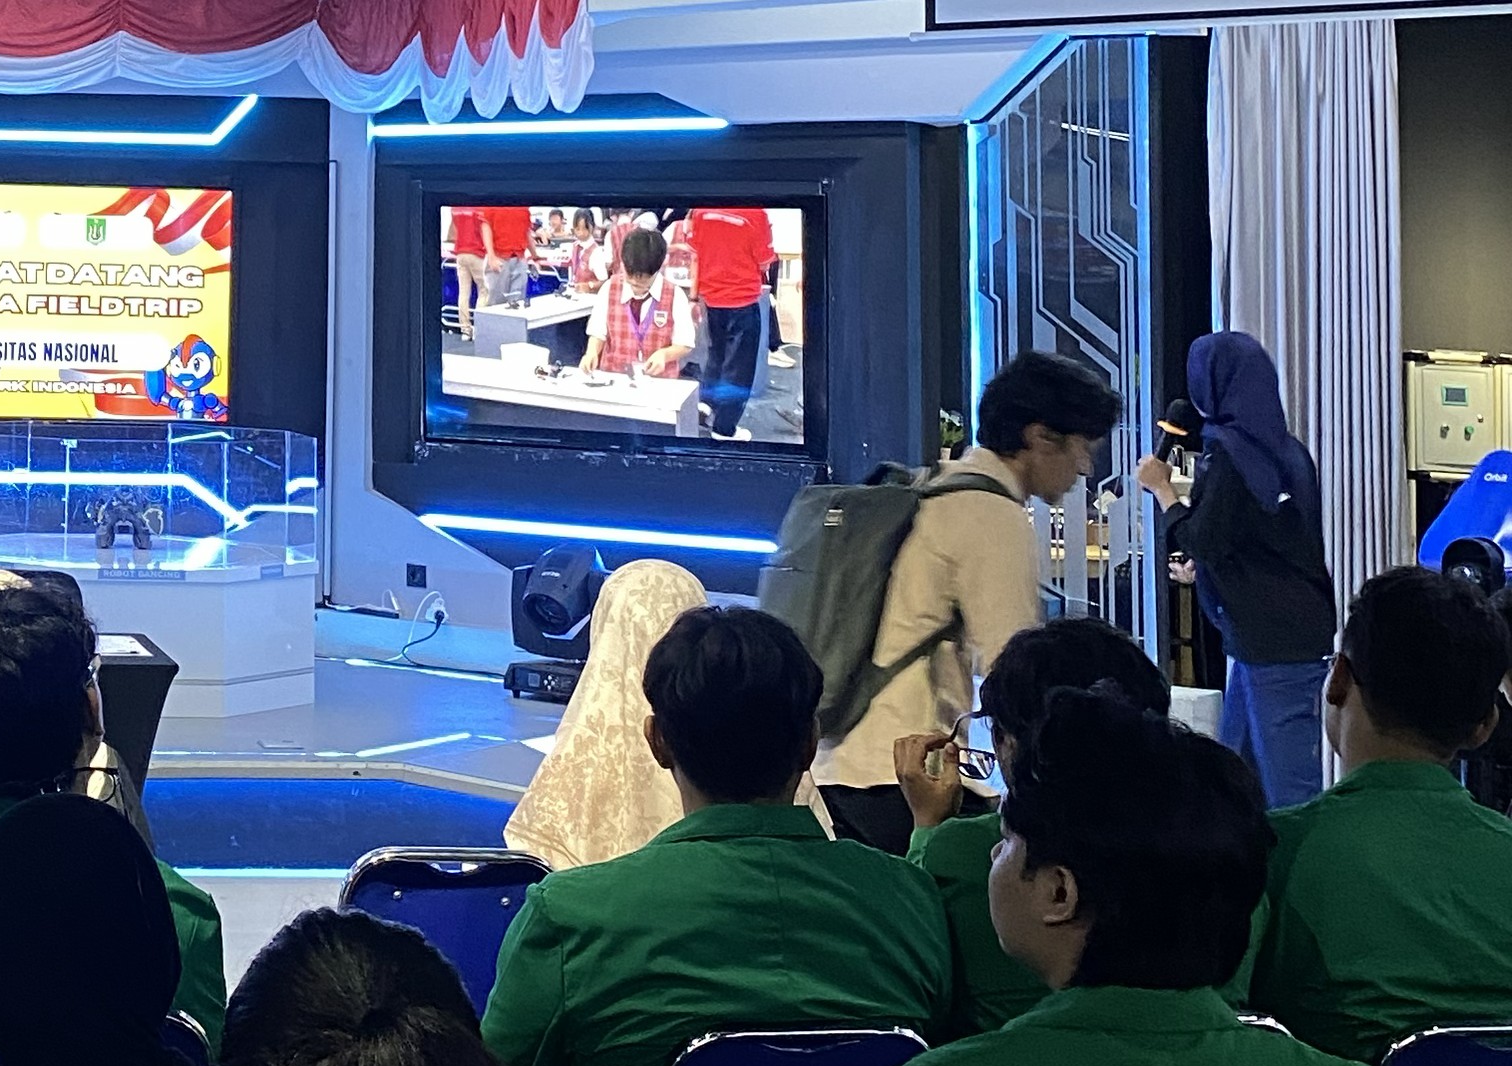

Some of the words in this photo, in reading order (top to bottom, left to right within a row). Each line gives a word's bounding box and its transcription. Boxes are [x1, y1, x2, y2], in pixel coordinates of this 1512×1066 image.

[46, 263, 205, 288] DATANG
[26, 294, 203, 318] FIELDTRIP
[43, 342, 119, 363] NASIONAL
[32, 381, 137, 395] INDONESIA
[103, 569, 136, 577] ROBOT
